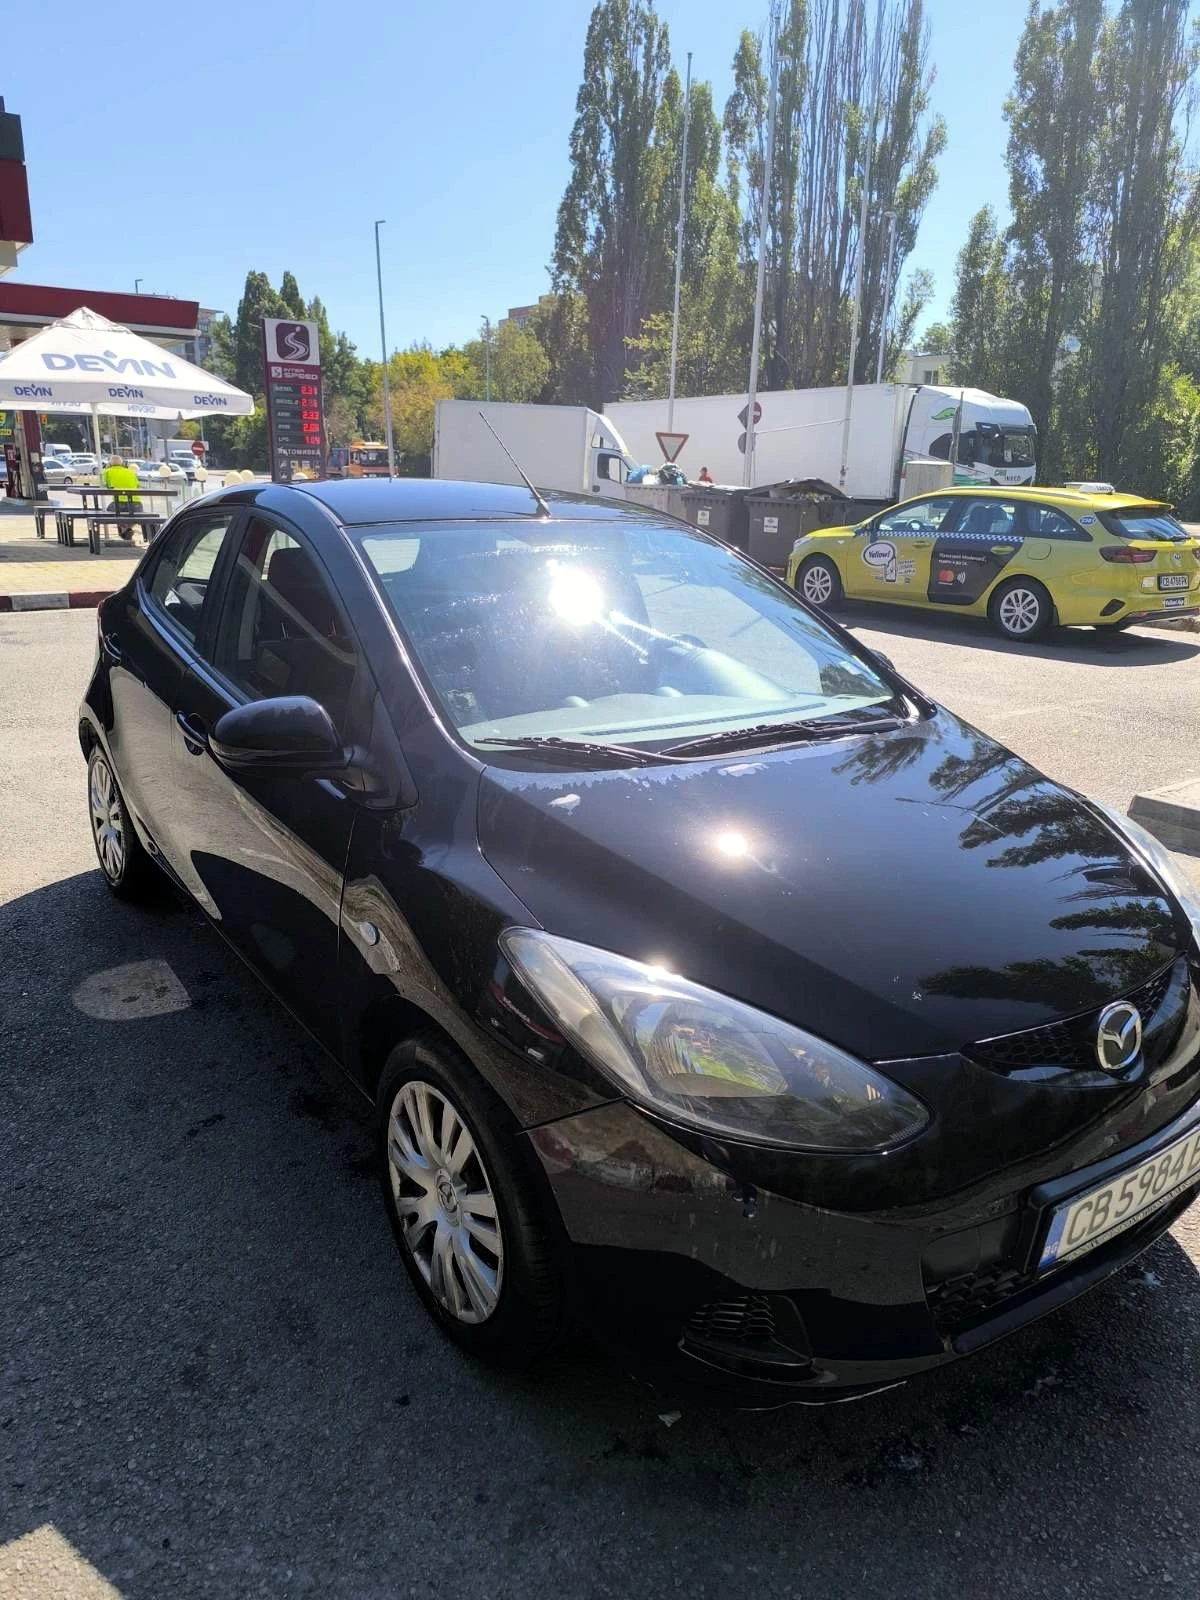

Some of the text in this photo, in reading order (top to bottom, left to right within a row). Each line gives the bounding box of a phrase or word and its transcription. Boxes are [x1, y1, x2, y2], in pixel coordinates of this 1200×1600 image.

[41, 350, 177, 379] DEVIN
[283, 372, 318, 380] SPEED
[14, 384, 53, 397] DEVIN
[108, 386, 144, 399] DEVIN
[194, 394, 228, 407] DEVIN
